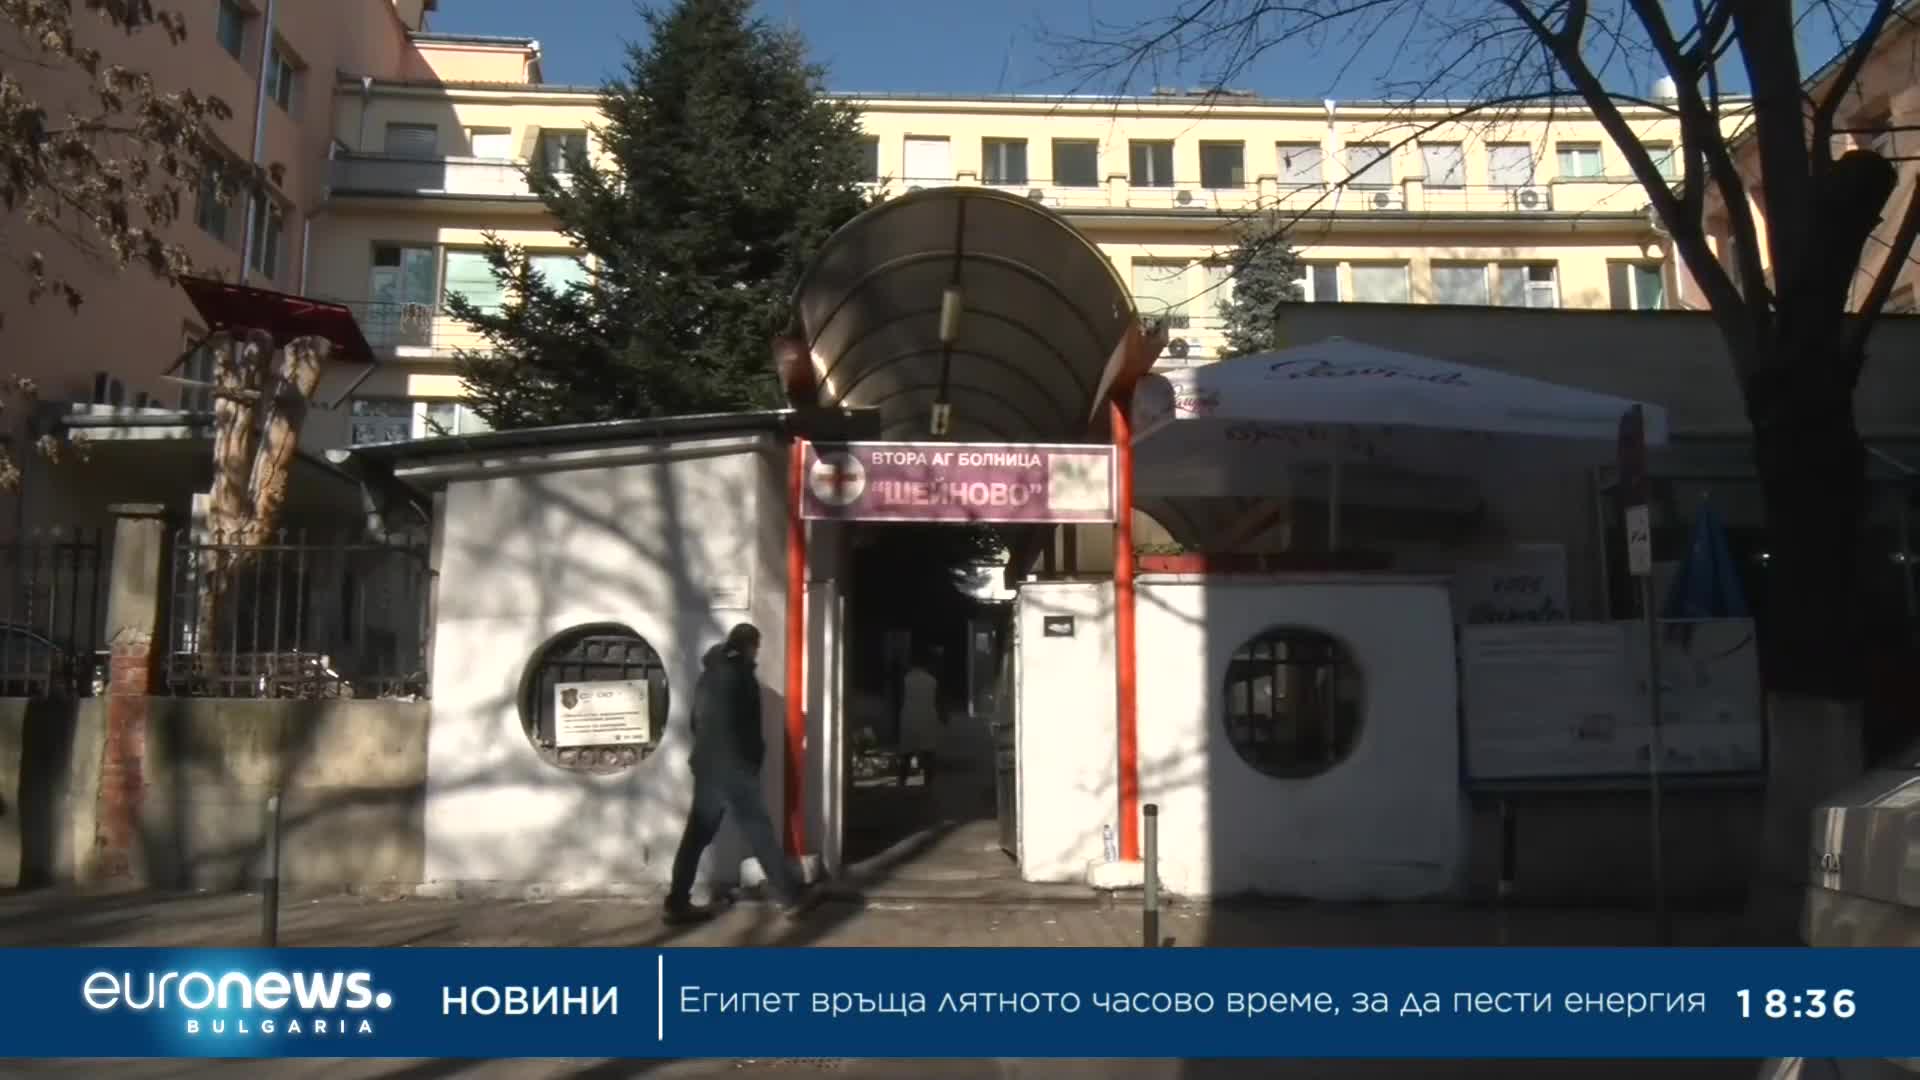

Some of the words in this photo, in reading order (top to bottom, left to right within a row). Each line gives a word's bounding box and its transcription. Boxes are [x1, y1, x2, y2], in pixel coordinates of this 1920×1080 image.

[871, 452, 928, 466] ВТОРА
[931, 452, 954, 467] АГ
[957, 452, 1043, 469] БОЛНИЦА
